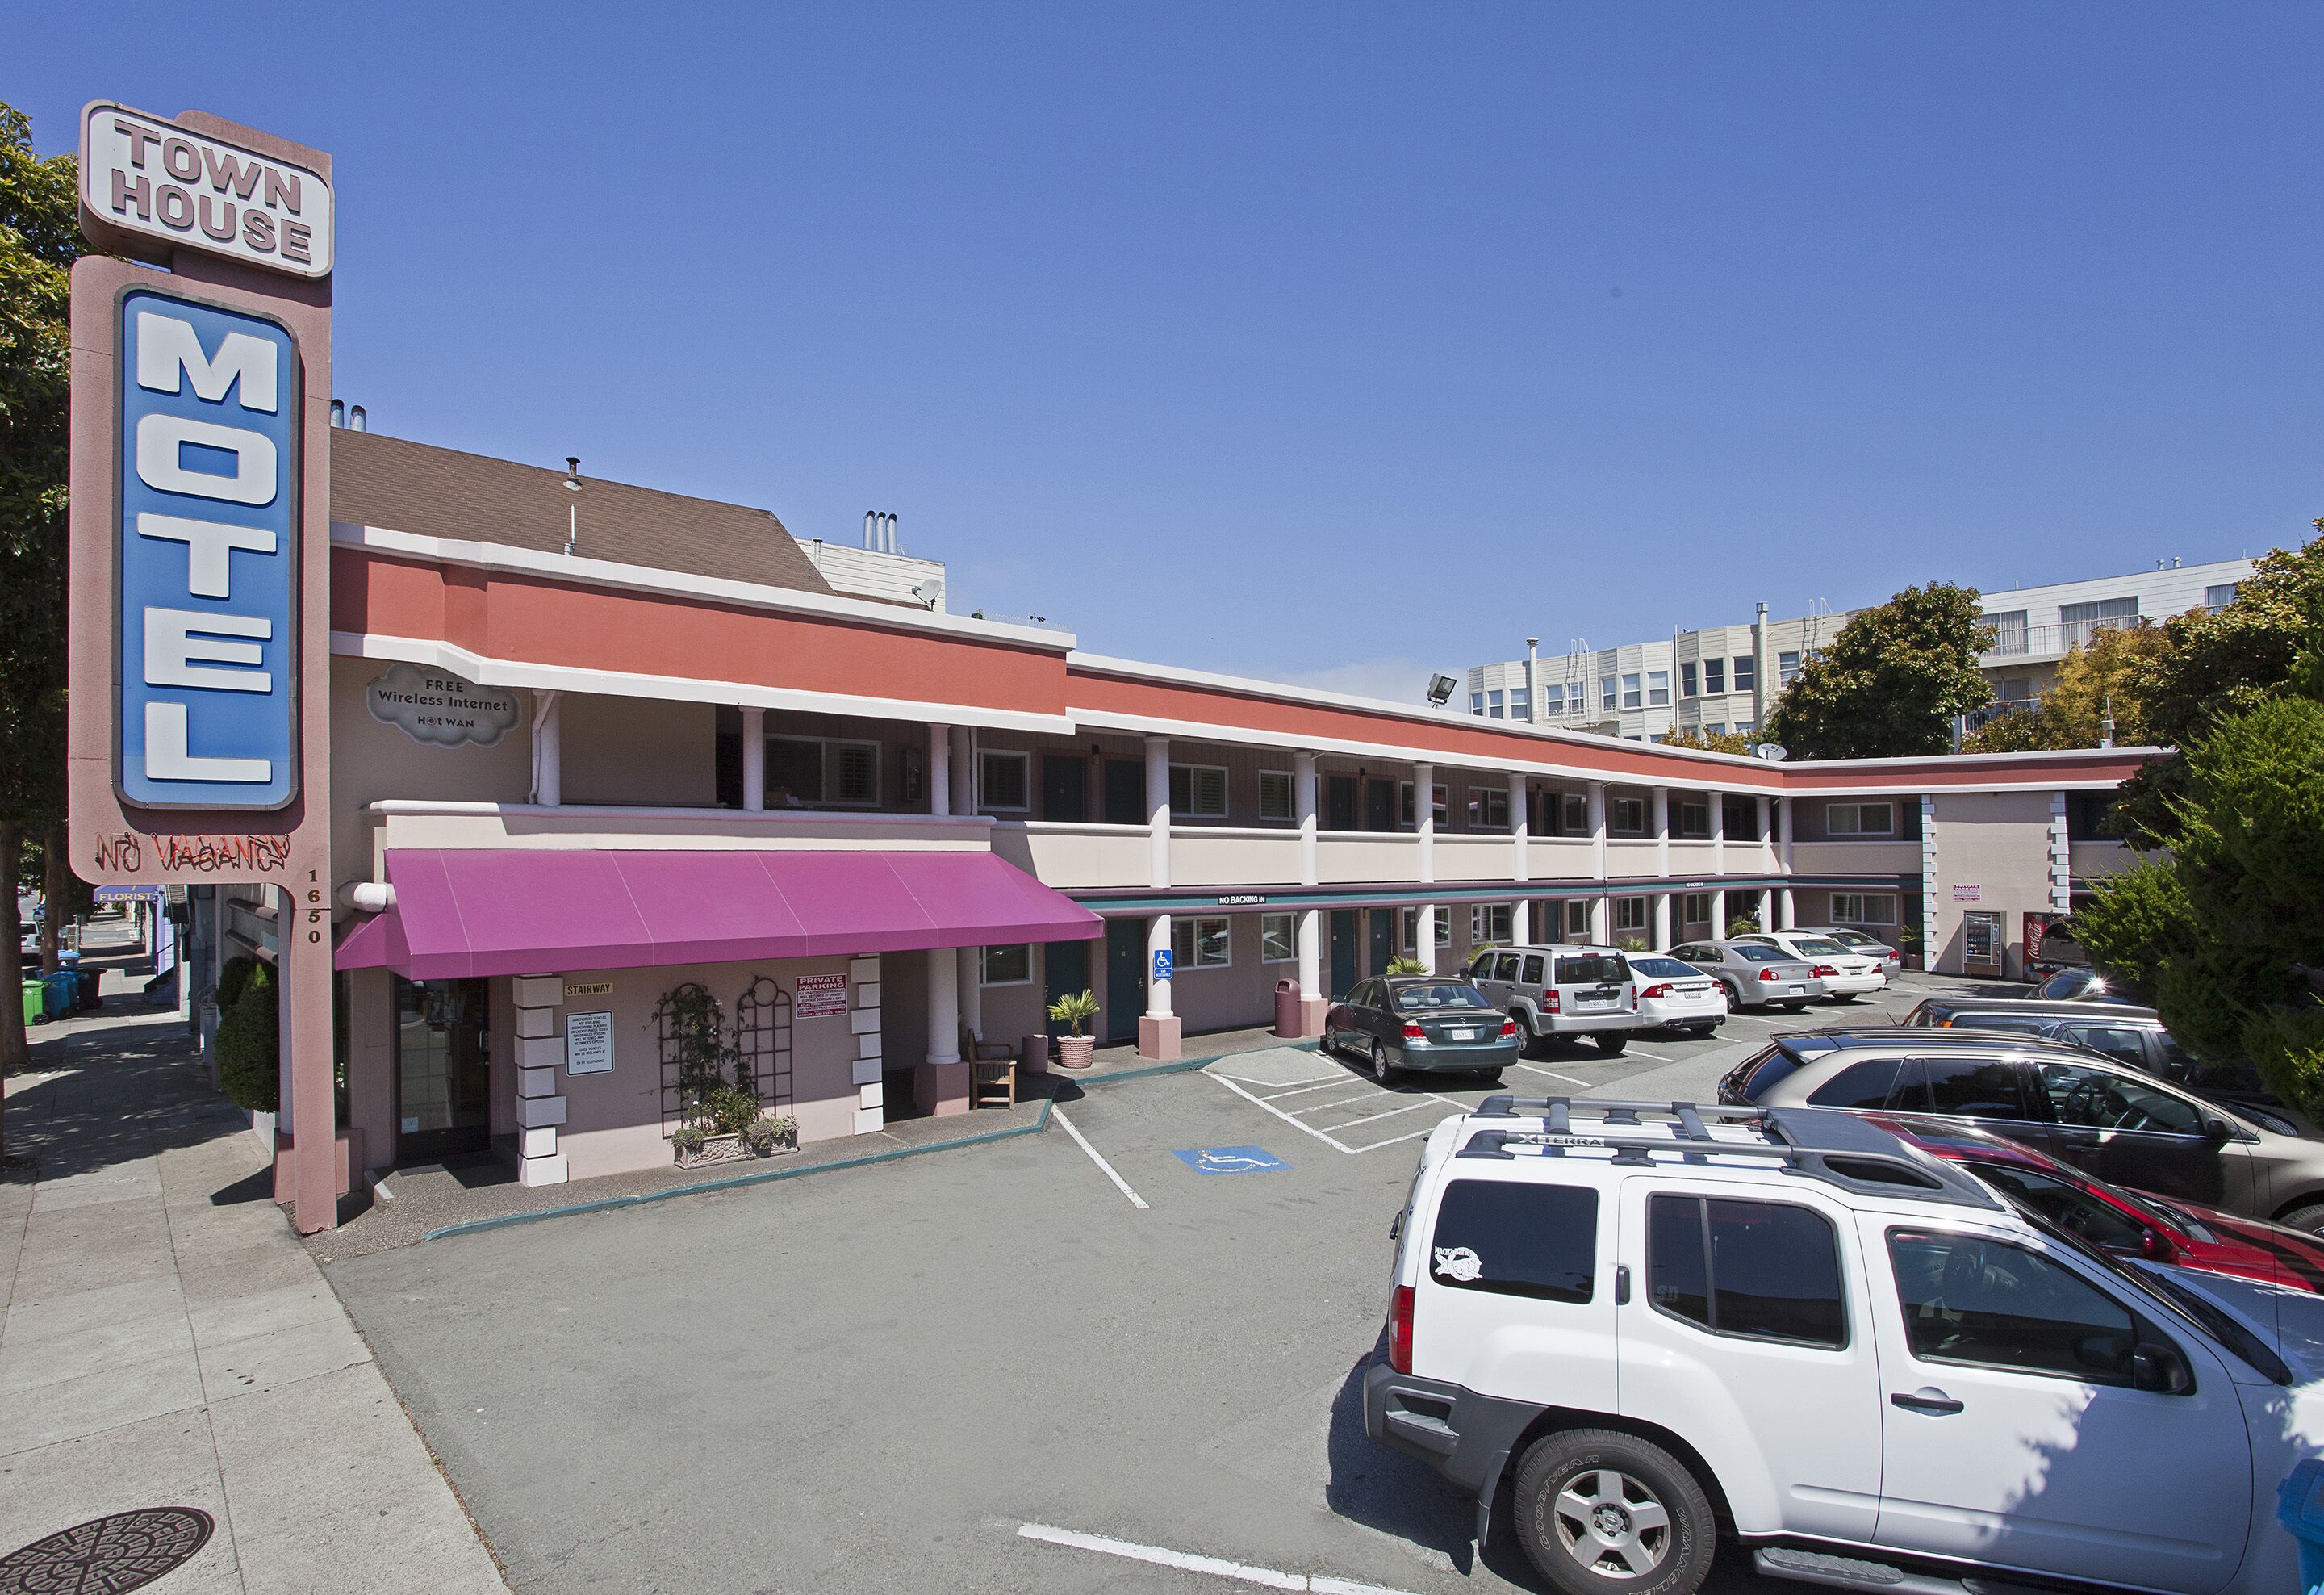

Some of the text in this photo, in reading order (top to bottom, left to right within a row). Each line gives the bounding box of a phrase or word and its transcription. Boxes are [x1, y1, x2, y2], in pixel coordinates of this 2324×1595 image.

[114, 119, 301, 216] TOWN
[111, 168, 311, 266] HOUSE
[136, 310, 278, 782] MOTEL
[426, 680, 463, 693] FREE
[378, 690, 508, 712] Wireless Internet
[446, 718, 474, 727] WAN
[95, 832, 291, 873] NO VACANCY
[99, 892, 153, 901] FLORIST
[307, 869, 321, 944] 1650
[1219, 895, 1265, 904] NO BACKING IN
[567, 983, 610, 995] STAIRWAY
[799, 982, 844, 990] PARKING
[800, 976, 843, 984] PRIVATE
[1535, 1455, 1600, 1550] GOODYEAR
[1628, 1506, 1691, 1595] WRANGLE
